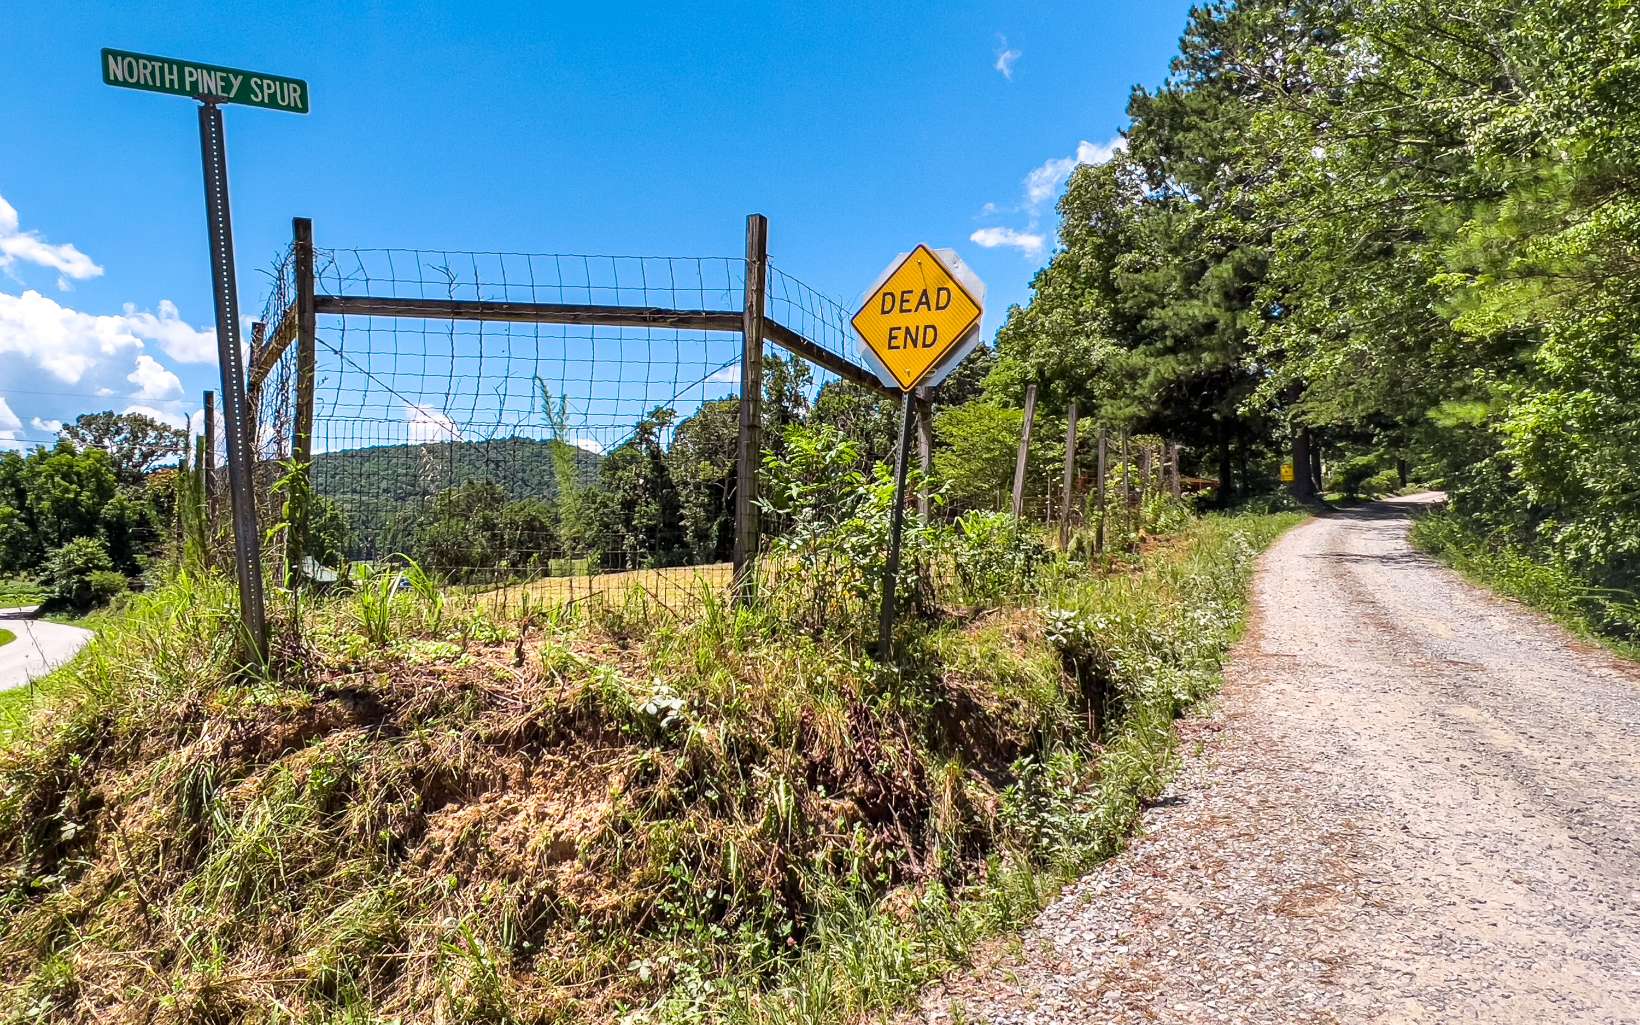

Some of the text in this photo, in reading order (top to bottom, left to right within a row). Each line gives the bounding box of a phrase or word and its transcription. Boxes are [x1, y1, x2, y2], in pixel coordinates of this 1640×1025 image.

[107, 54, 303, 108] NORTH PINEY SPUR
[880, 287, 952, 315] DEAD
[887, 324, 938, 350] END
